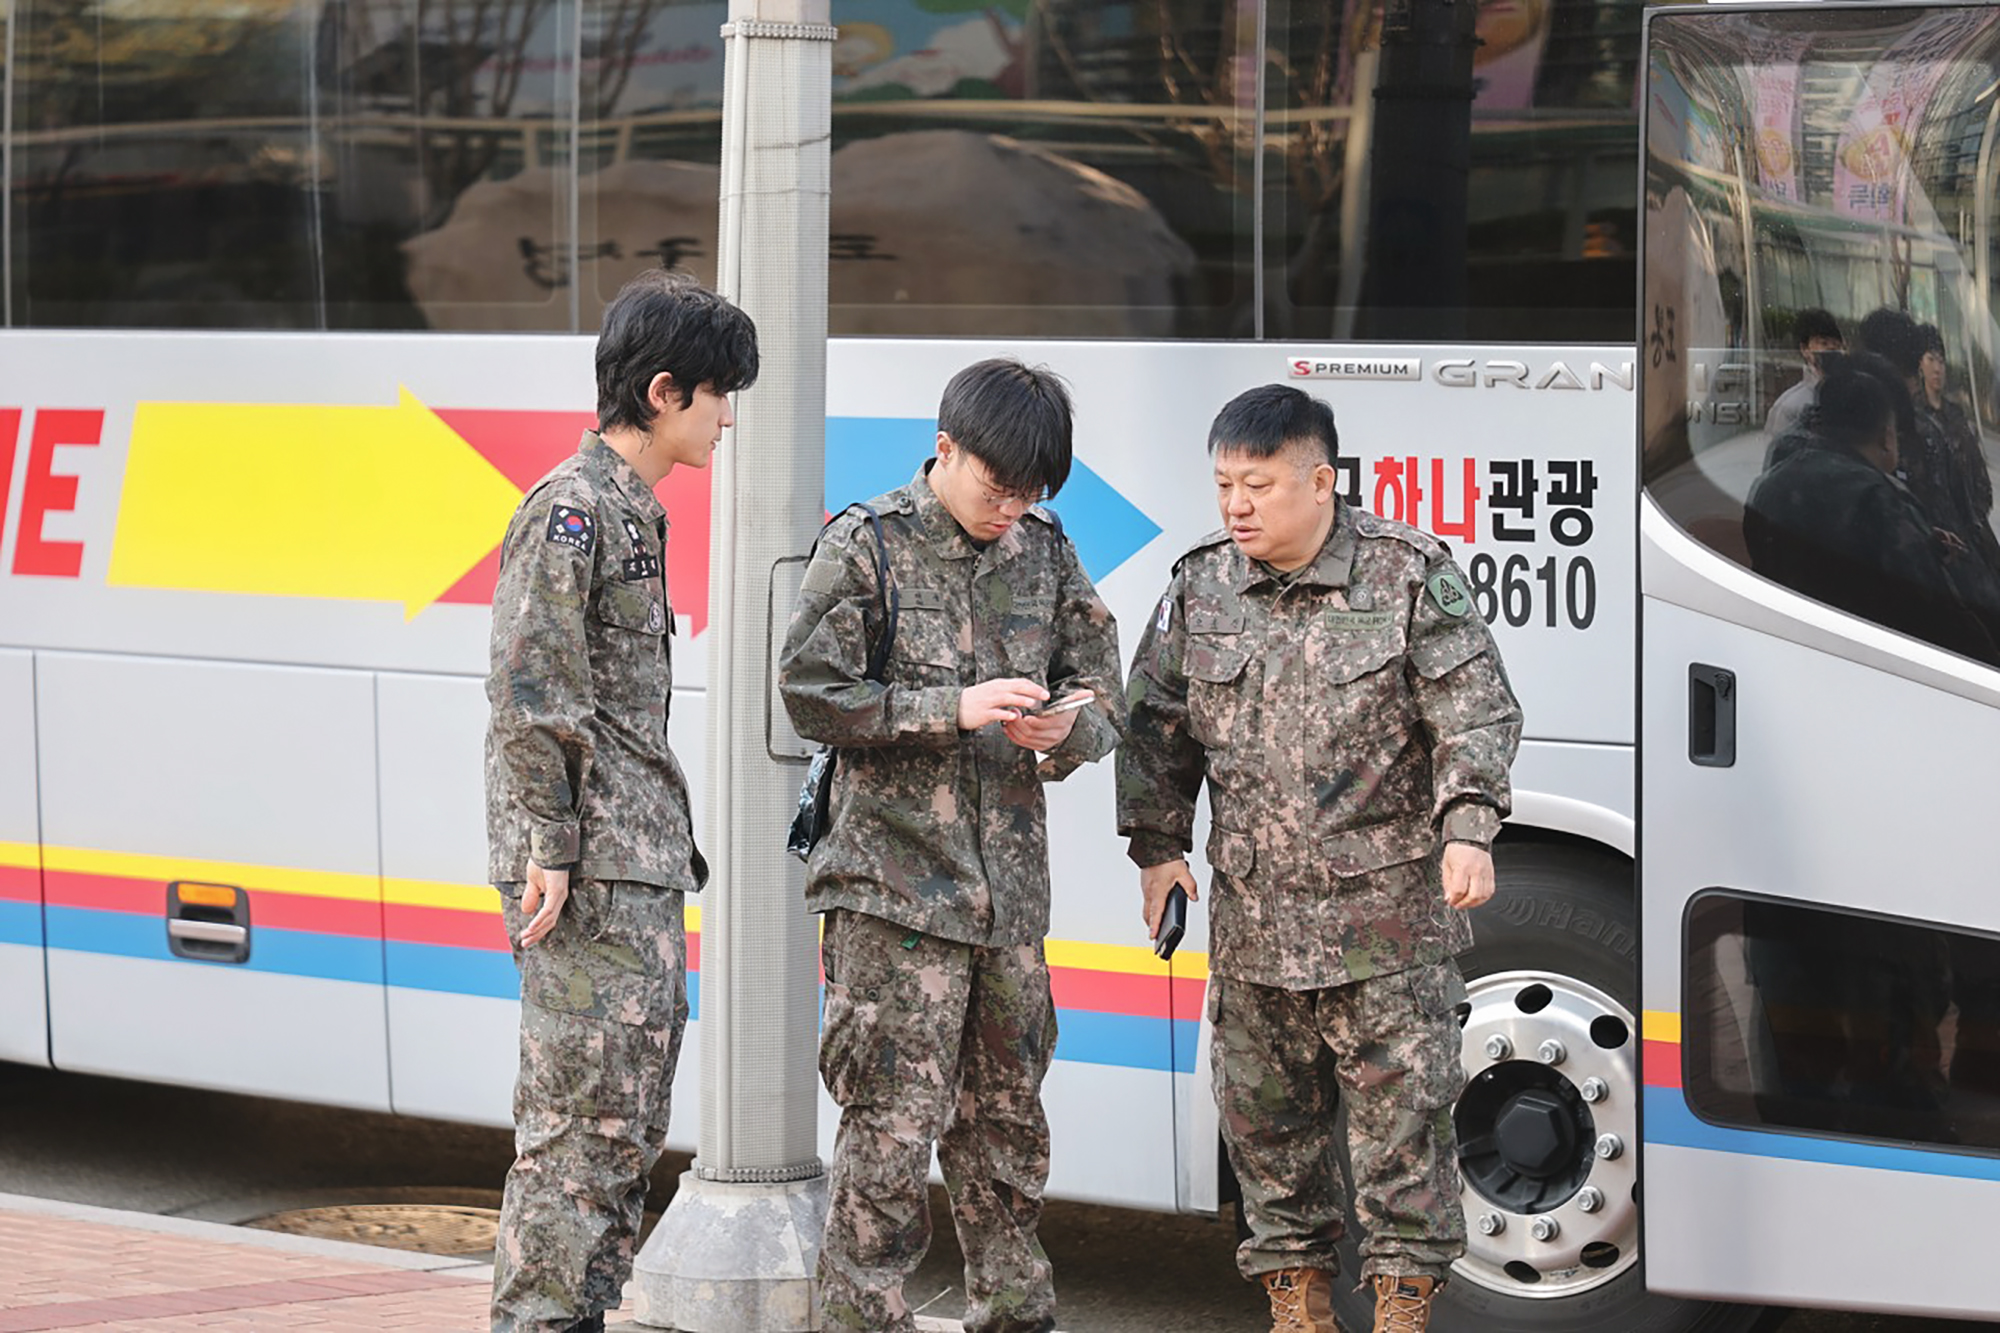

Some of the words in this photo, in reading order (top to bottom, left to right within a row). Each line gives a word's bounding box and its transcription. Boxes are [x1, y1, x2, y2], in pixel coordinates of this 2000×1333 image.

[1316, 363, 1408, 375] PREMIUM
[553, 534, 586, 550] KOREA
[1470, 553, 1596, 630] 8610
[1538, 900, 1636, 963] Han
